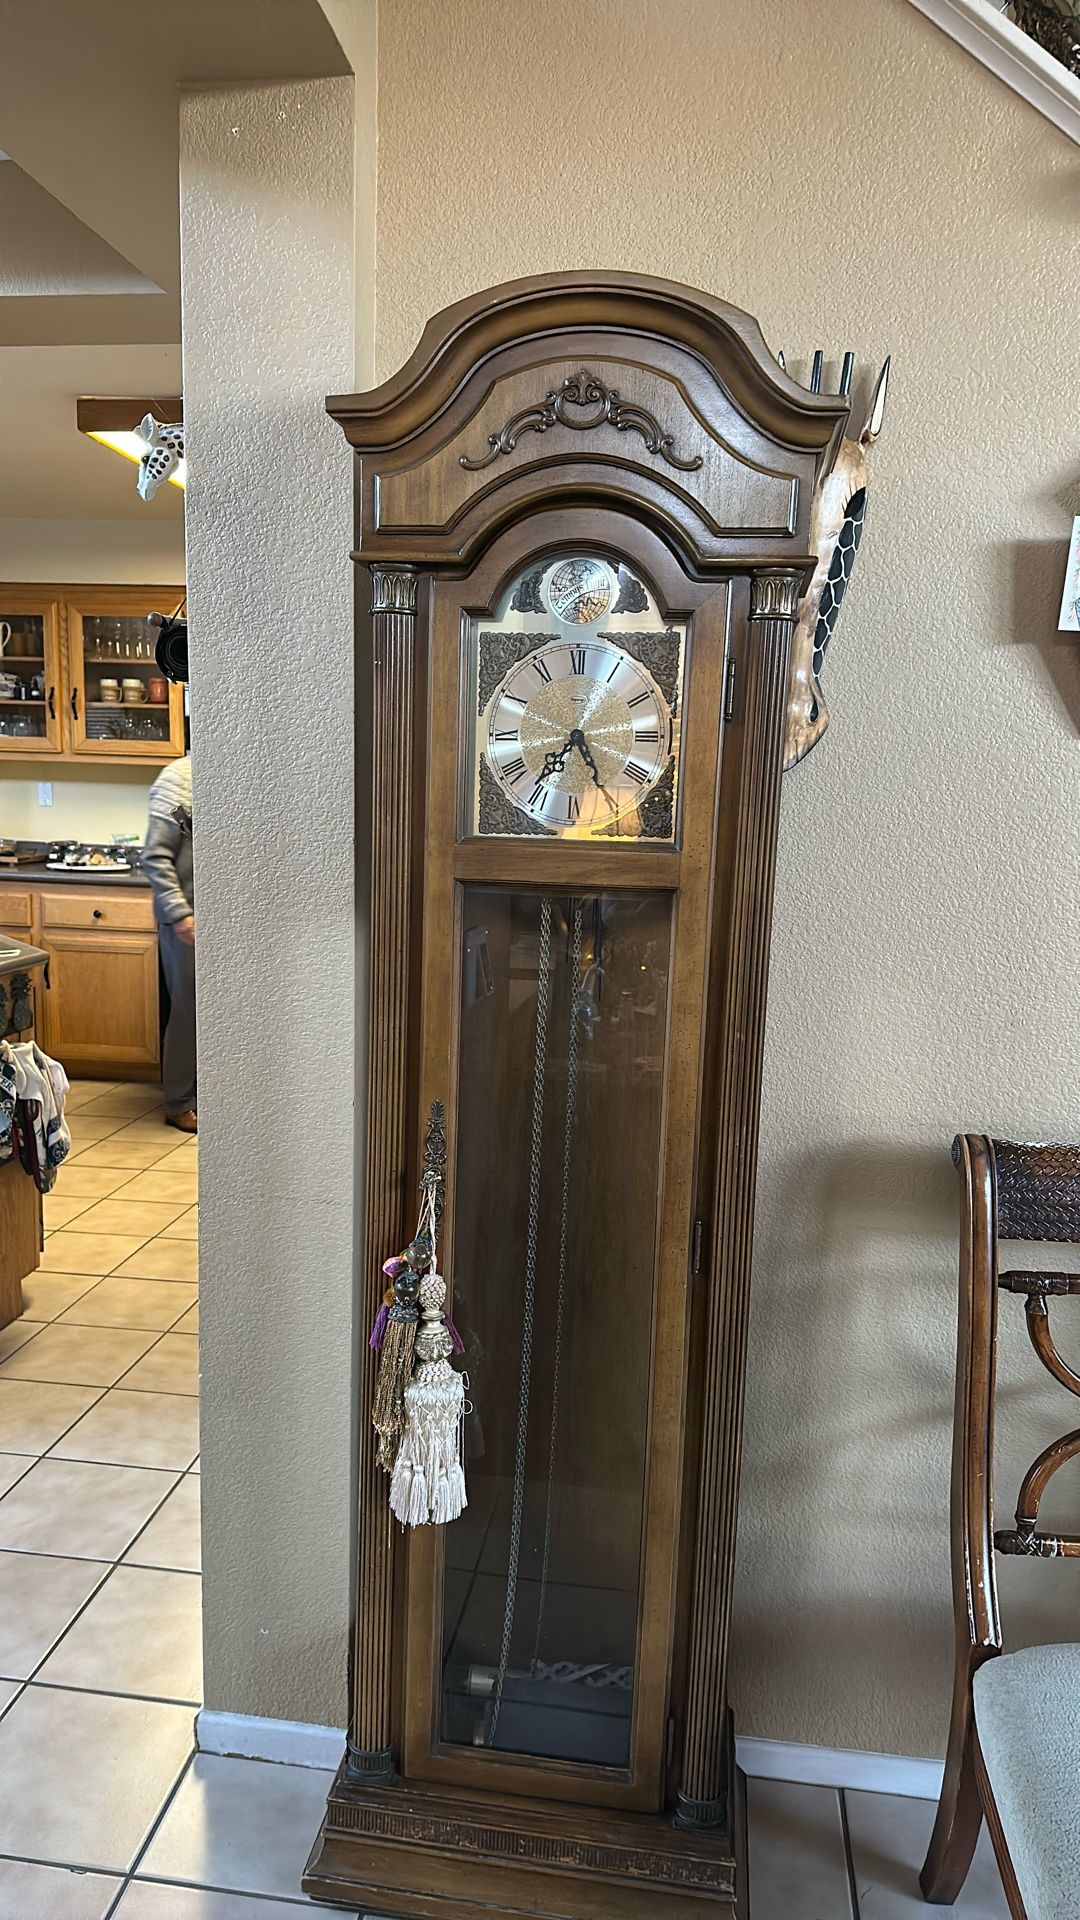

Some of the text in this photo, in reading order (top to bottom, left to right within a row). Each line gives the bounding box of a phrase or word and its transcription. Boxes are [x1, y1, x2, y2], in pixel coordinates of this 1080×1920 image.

[568, 650, 586, 675] XII
[606, 662, 620, 682] I
[504, 688, 528, 708] X
[627, 691, 649, 708] II
[494, 728, 518, 741] IX
[635, 731, 658, 742] III
[501, 757, 527, 785] VIII
[623, 761, 649, 785] IIII
[527, 783, 549, 811] VII
[567, 795, 580, 819] VI
